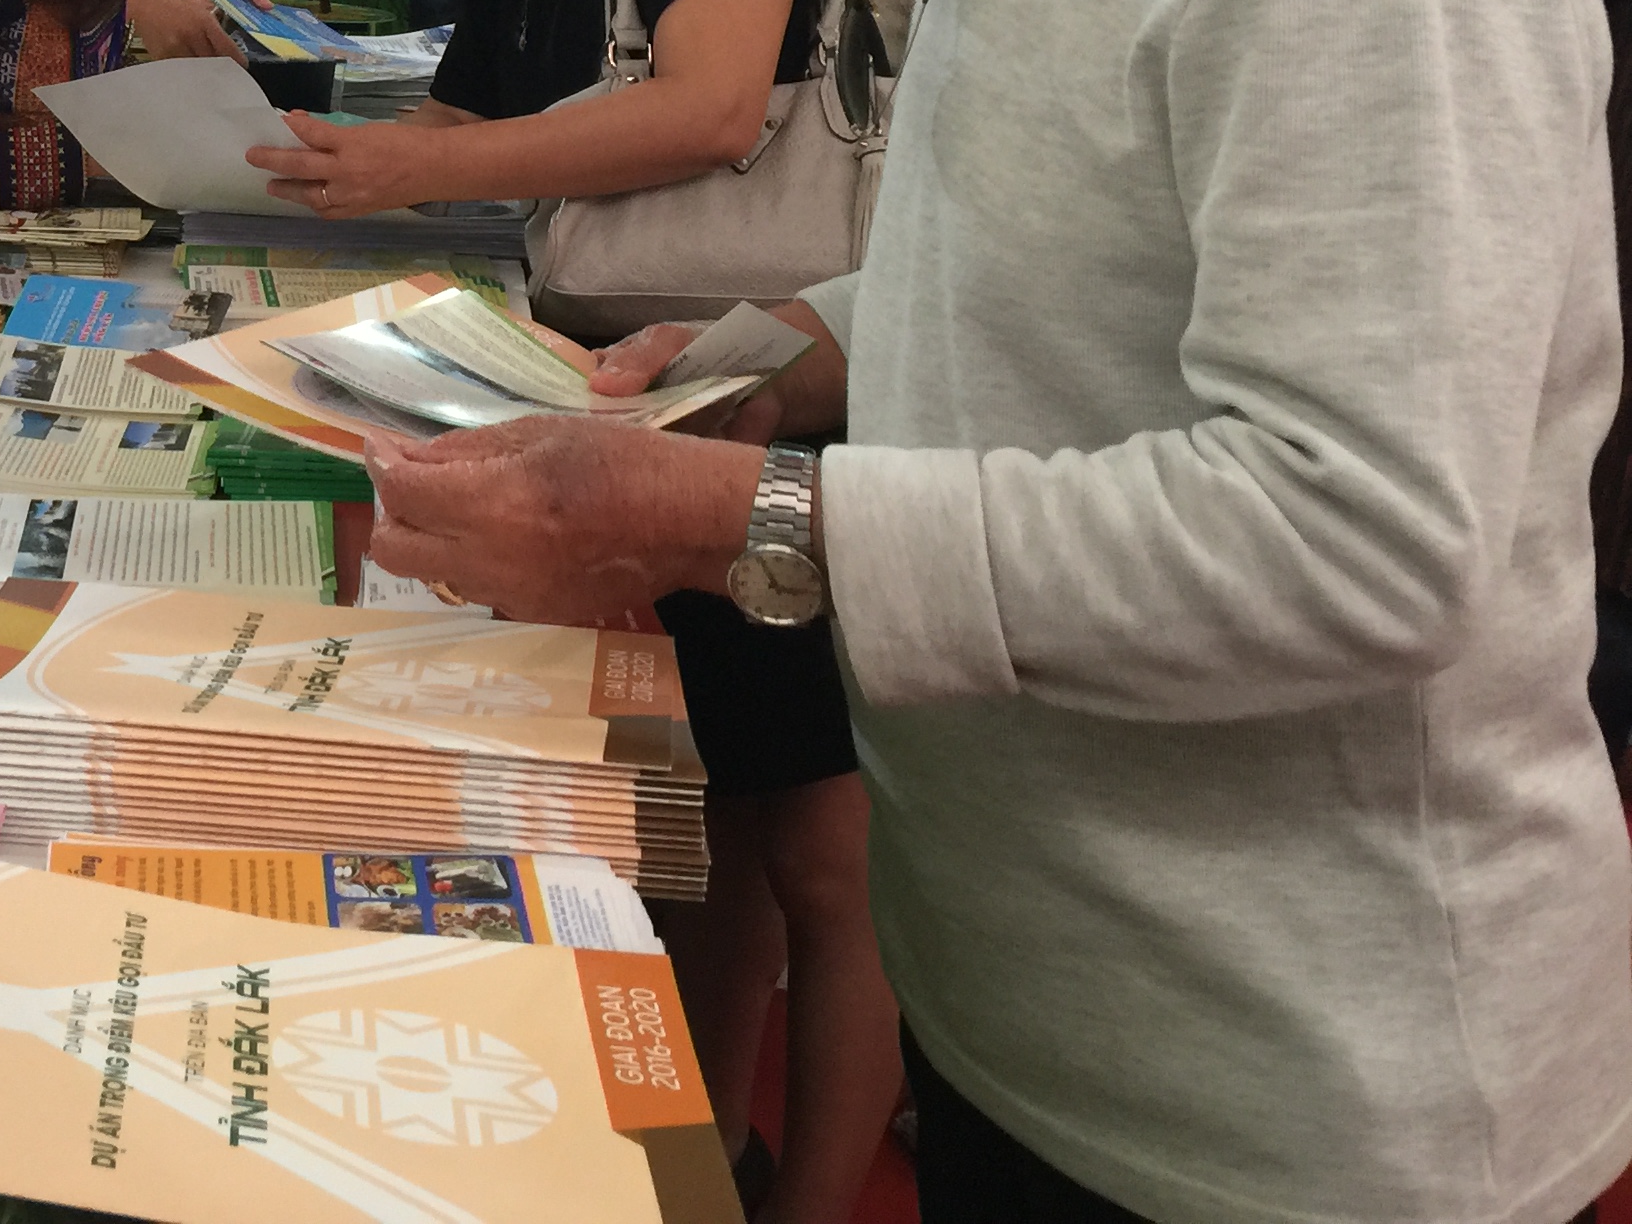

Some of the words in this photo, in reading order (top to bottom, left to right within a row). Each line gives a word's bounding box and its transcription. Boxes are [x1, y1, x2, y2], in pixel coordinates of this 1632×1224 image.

[311, 637, 352, 665] LẮK
[298, 667, 340, 692] ĐẮK
[604, 679, 627, 699] GIAI
[630, 652, 655, 704] 2016-2020
[282, 692, 327, 712] TỈNH
[124, 910, 148, 929] TƯ
[112, 930, 146, 960] ĐẦU
[117, 960, 148, 989] GỌI
[221, 963, 270, 1015] LẮK
[108, 988, 138, 1016] KÊU
[596, 984, 634, 1041] ĐOẠN
[63, 1019, 86, 1054] DANH
[97, 1018, 135, 1054] ĐIỂM
[218, 1018, 269, 1076] ĐẮK
[629, 987, 681, 1091] 2016-2020
[182, 1049, 206, 1082] TRÊN
[608, 1044, 645, 1085] GIAI
[99, 1055, 134, 1111] TRỌNG
[89, 1110, 122, 1139] ÁN
[218, 1081, 268, 1147] TỈNH
[90, 1137, 126, 1170] DỰ
